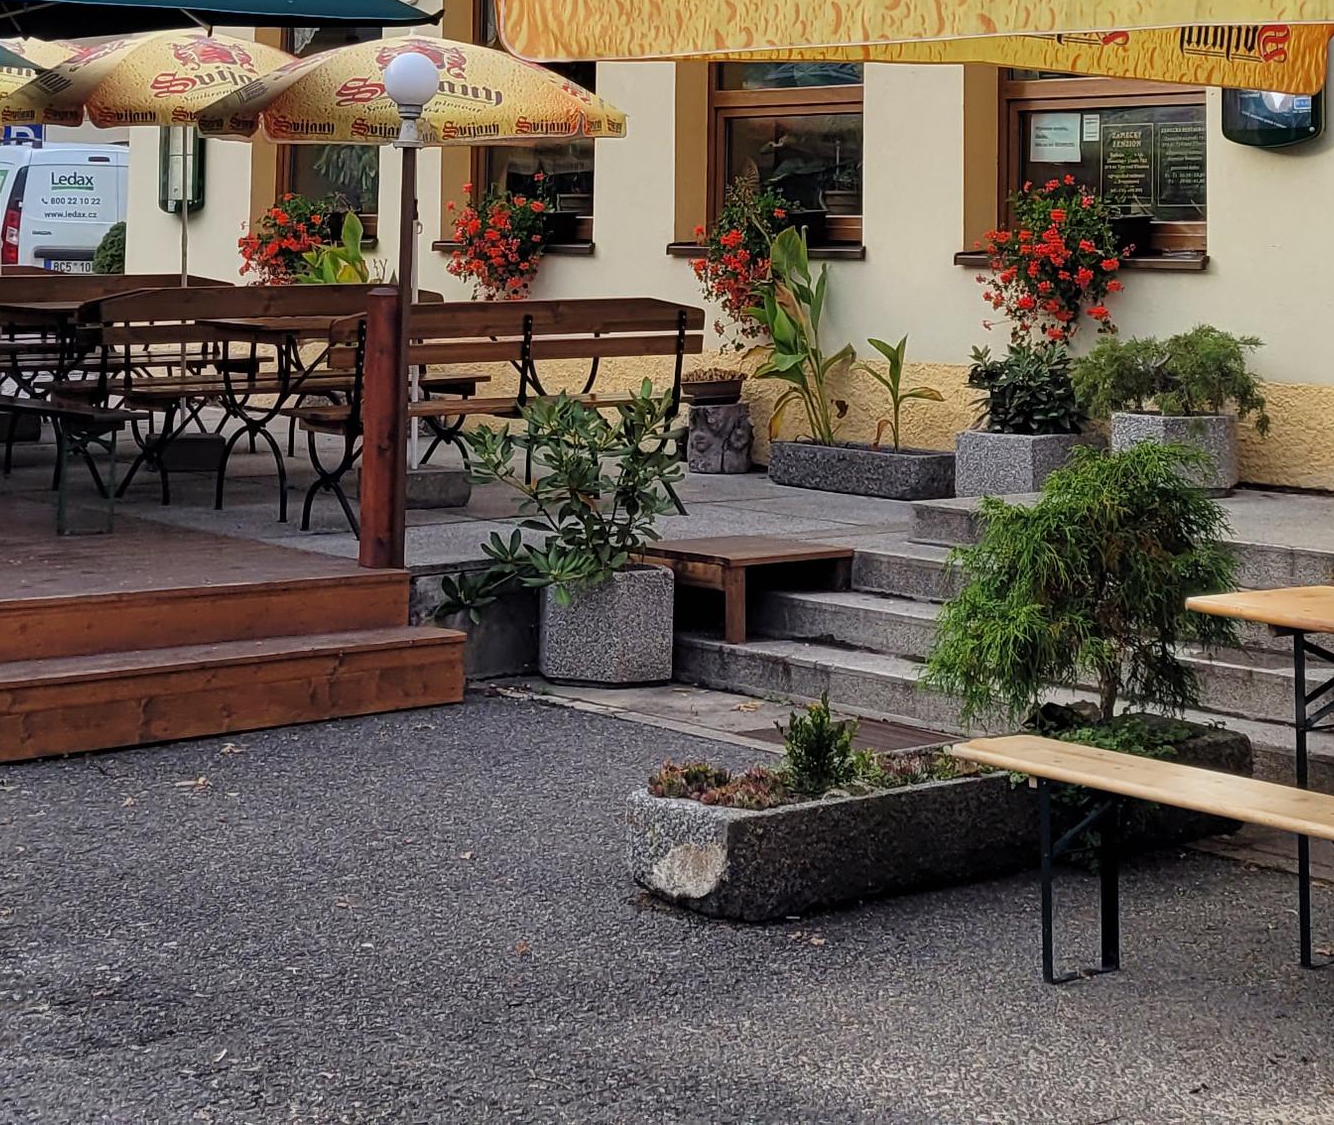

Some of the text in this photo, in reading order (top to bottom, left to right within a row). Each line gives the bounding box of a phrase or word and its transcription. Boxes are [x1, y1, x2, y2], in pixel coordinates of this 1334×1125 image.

[335, 76, 503, 107] Sany
[99, 104, 157, 123] Svijany
[273, 115, 335, 136] Svijany
[441, 119, 500, 140] Svijany
[514, 115, 571, 136] Svijany
[51, 171, 94, 186] Ledax
[50, 197, 101, 205] 800 22 10 22
[44, 210, 98, 219] www.ledax.cz
